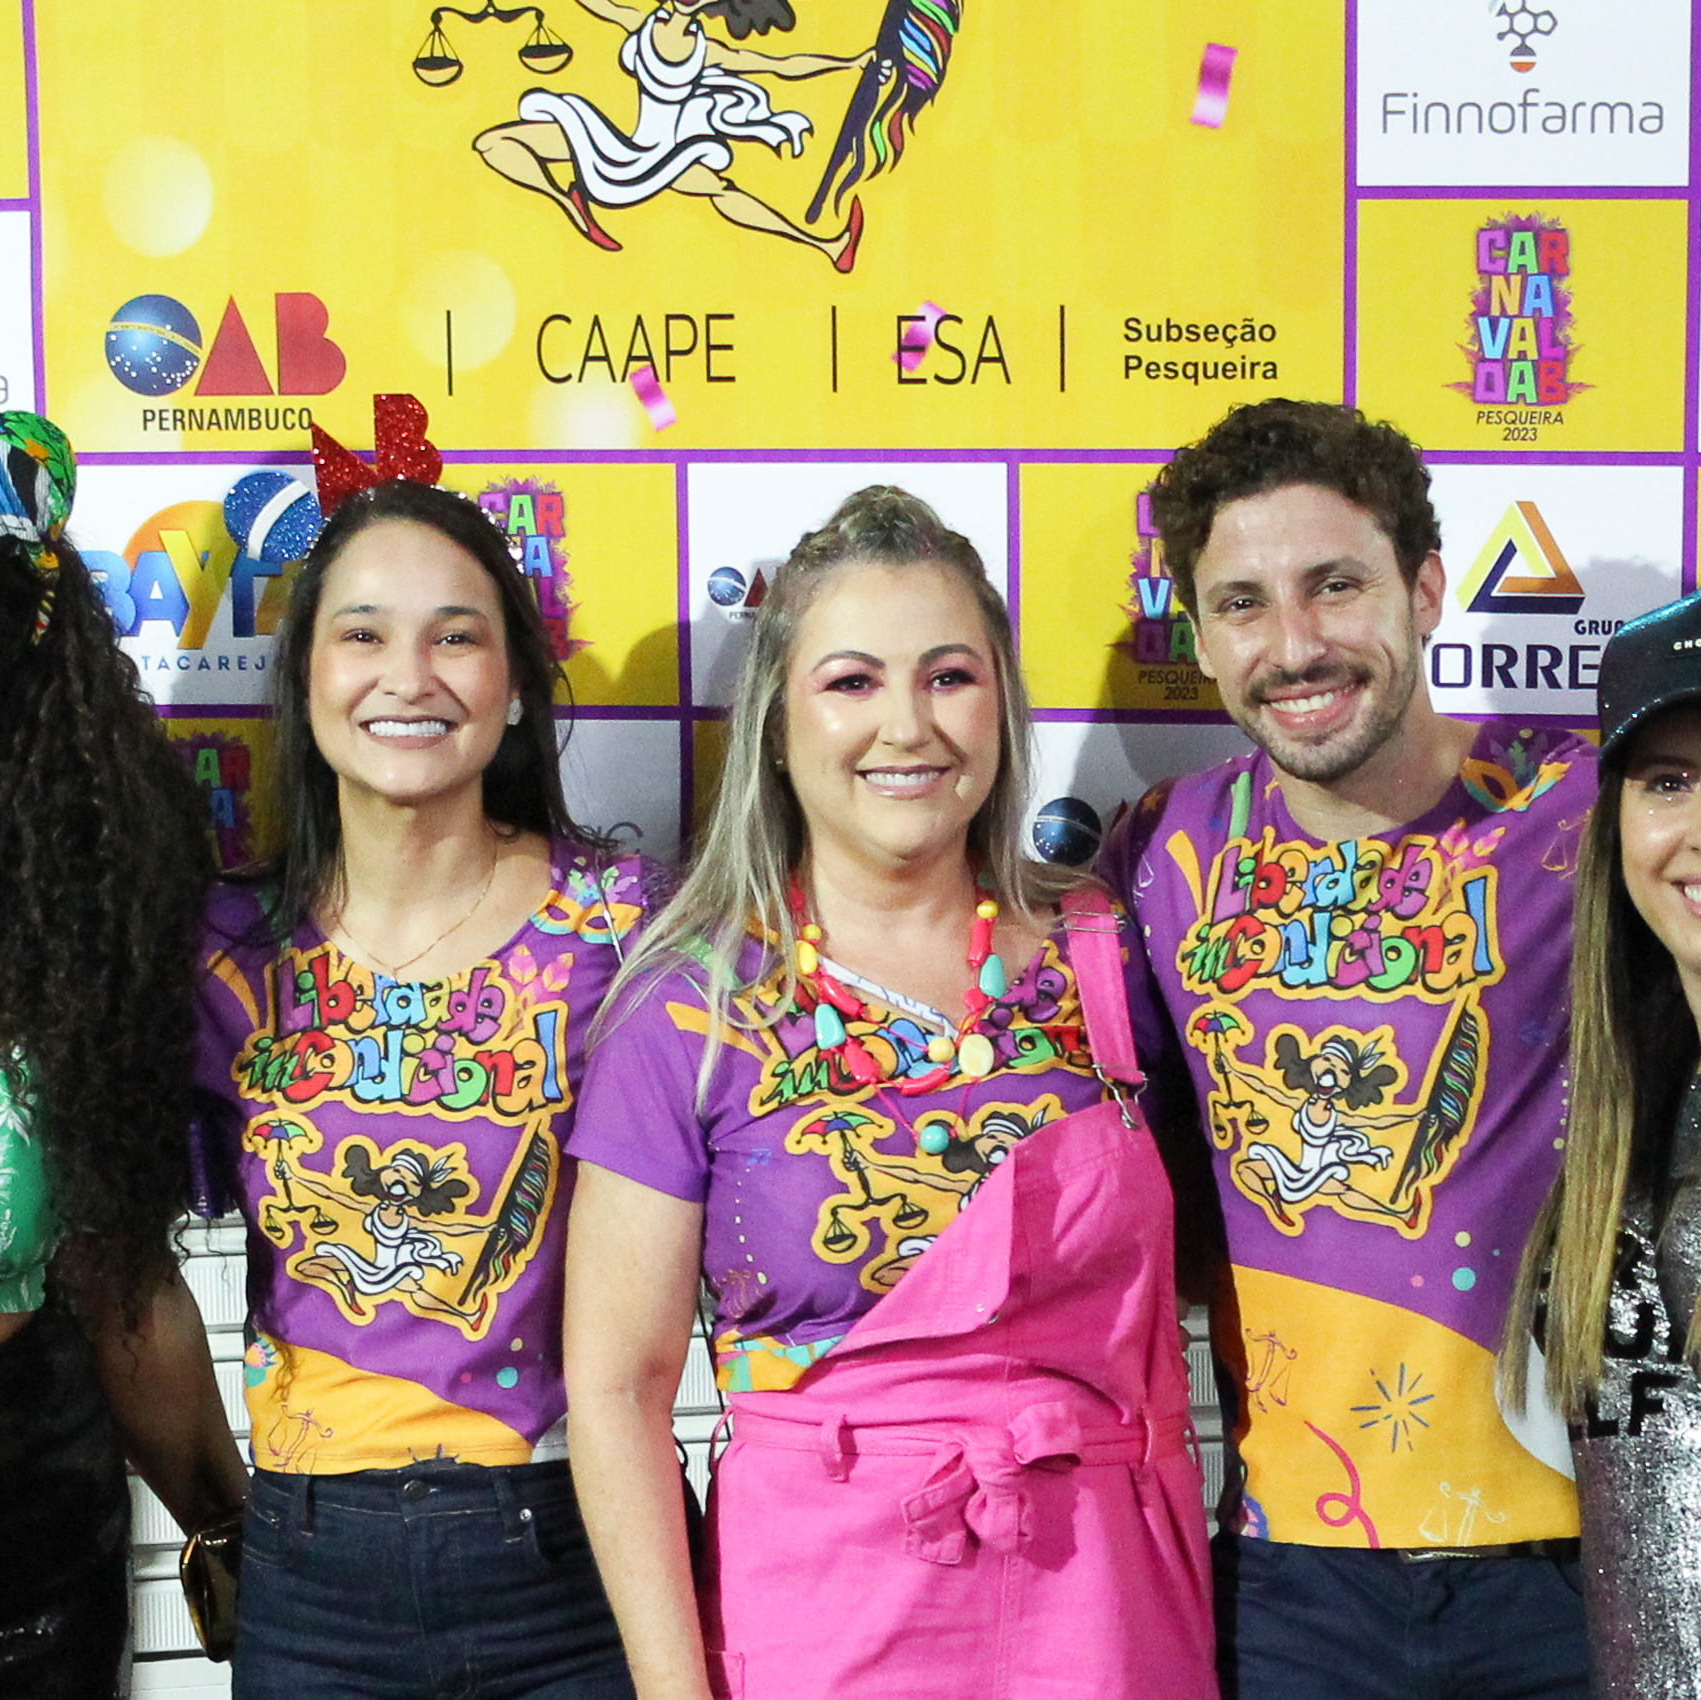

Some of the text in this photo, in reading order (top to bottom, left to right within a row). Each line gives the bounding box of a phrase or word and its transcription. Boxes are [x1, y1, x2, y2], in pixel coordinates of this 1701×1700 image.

[1382, 88, 1664, 135] Finnofarma
[1477, 229, 1570, 276] CAR
[1490, 274, 1555, 317] NA
[104, 291, 347, 397] OAB
[536, 313, 737, 385] CAAPE
[896, 314, 1011, 386] ESA
[1123, 317, 1277, 348] Subseção
[1477, 316, 1567, 361] VAL
[1123, 354, 1279, 387] Pesqueira
[1473, 361, 1569, 405] OAB
[142, 407, 312, 432] PERNAMBUCO
[1476, 410, 1565, 425] PESQUEIRA
[1502, 428, 1538, 442] 2023
[142, 655, 266, 671] TACAREJ
[1134, 618, 1197, 664] OA
[1432, 643, 1601, 689] ORRE
[1164, 686, 1199, 702] 2023
[1211, 840, 1433, 922] Liberdade
[272, 952, 505, 1044] Liberdade
